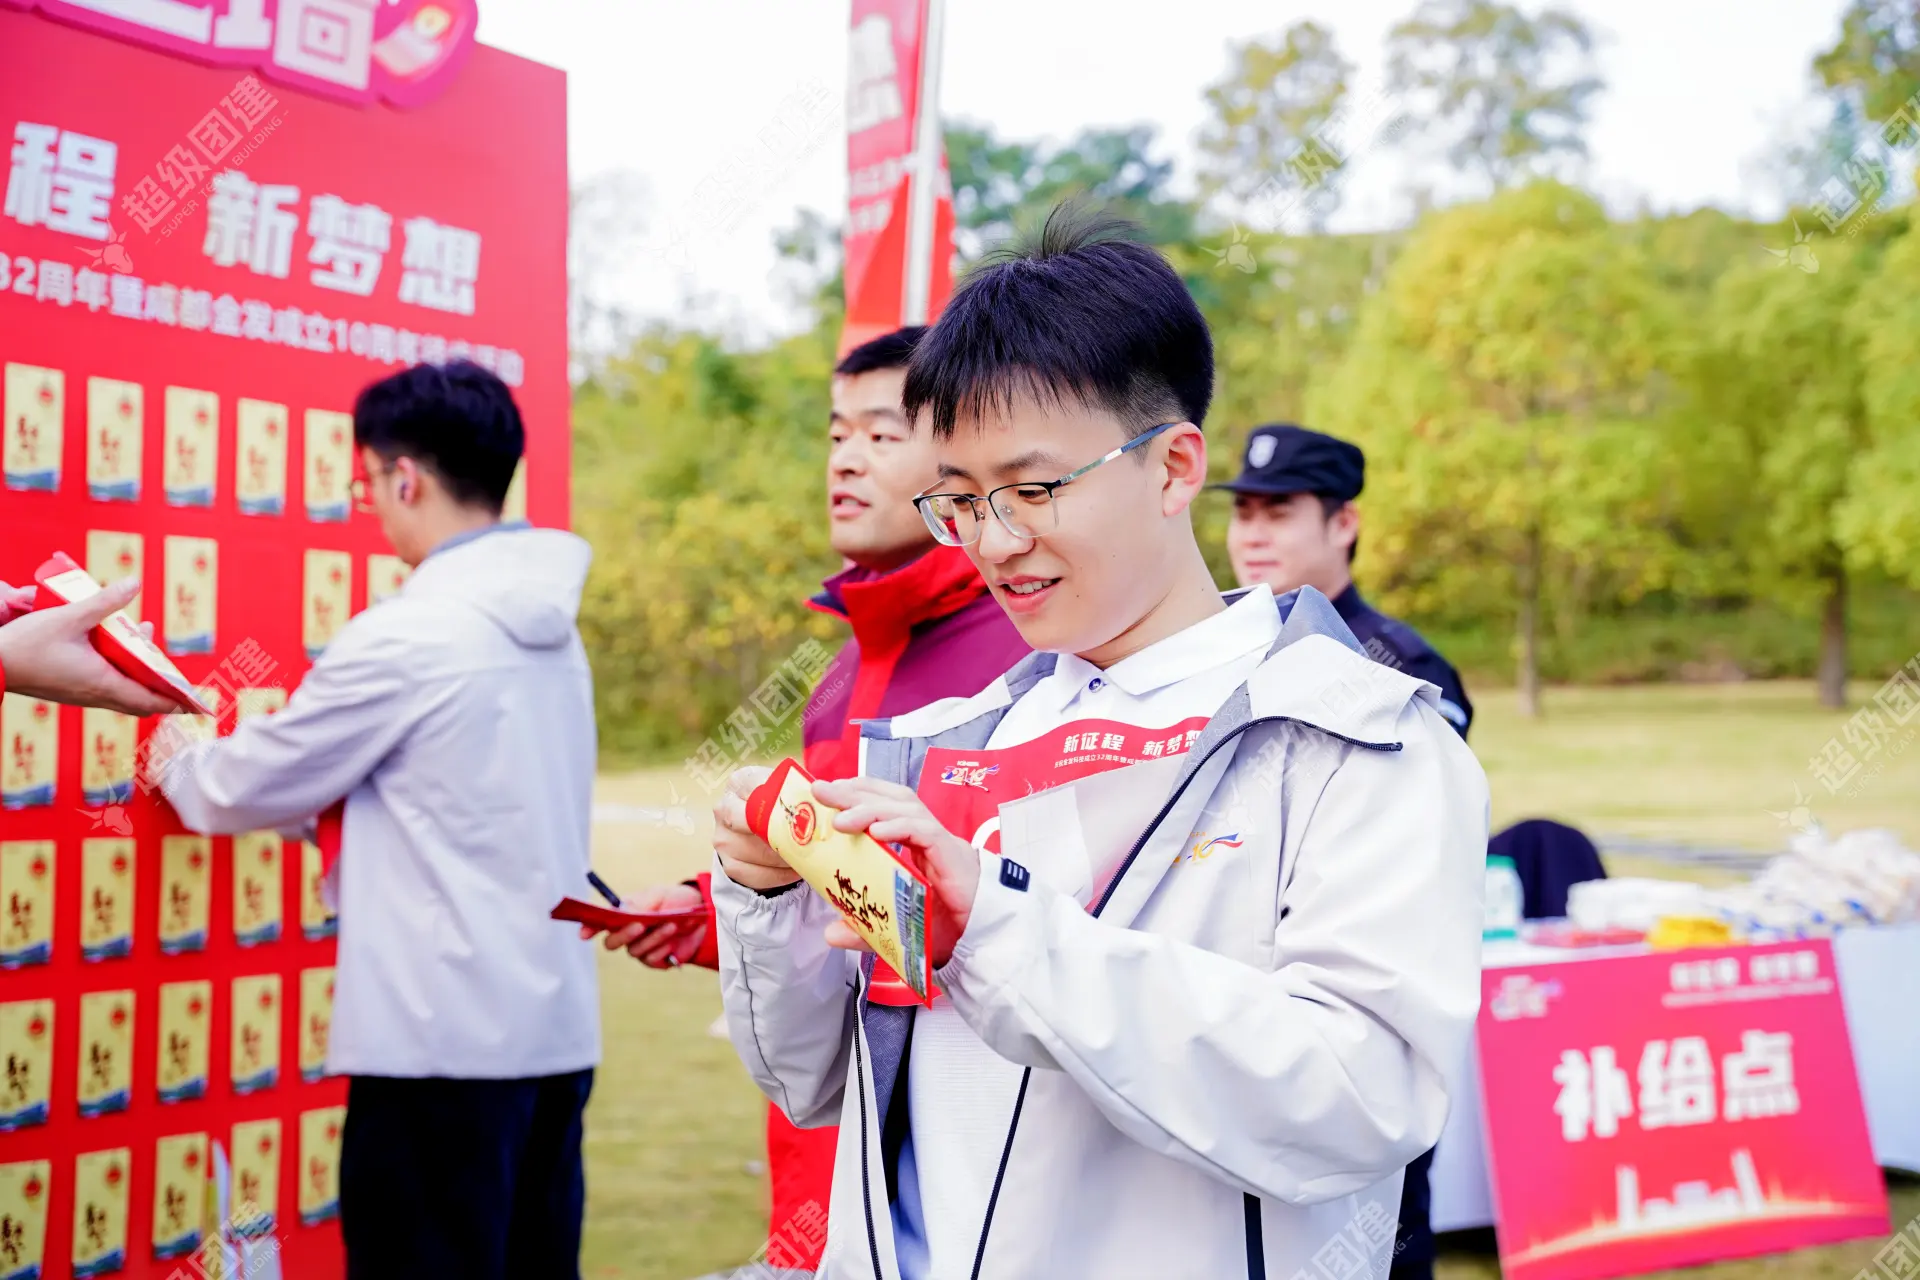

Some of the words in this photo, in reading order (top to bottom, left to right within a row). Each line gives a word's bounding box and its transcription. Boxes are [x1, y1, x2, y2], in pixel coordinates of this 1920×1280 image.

[4, 121, 117, 240] 程
[203, 170, 481, 316] 新梦想
[1063, 732, 1125, 754] 新征程
[1553, 1029, 1800, 1142] 补给点
